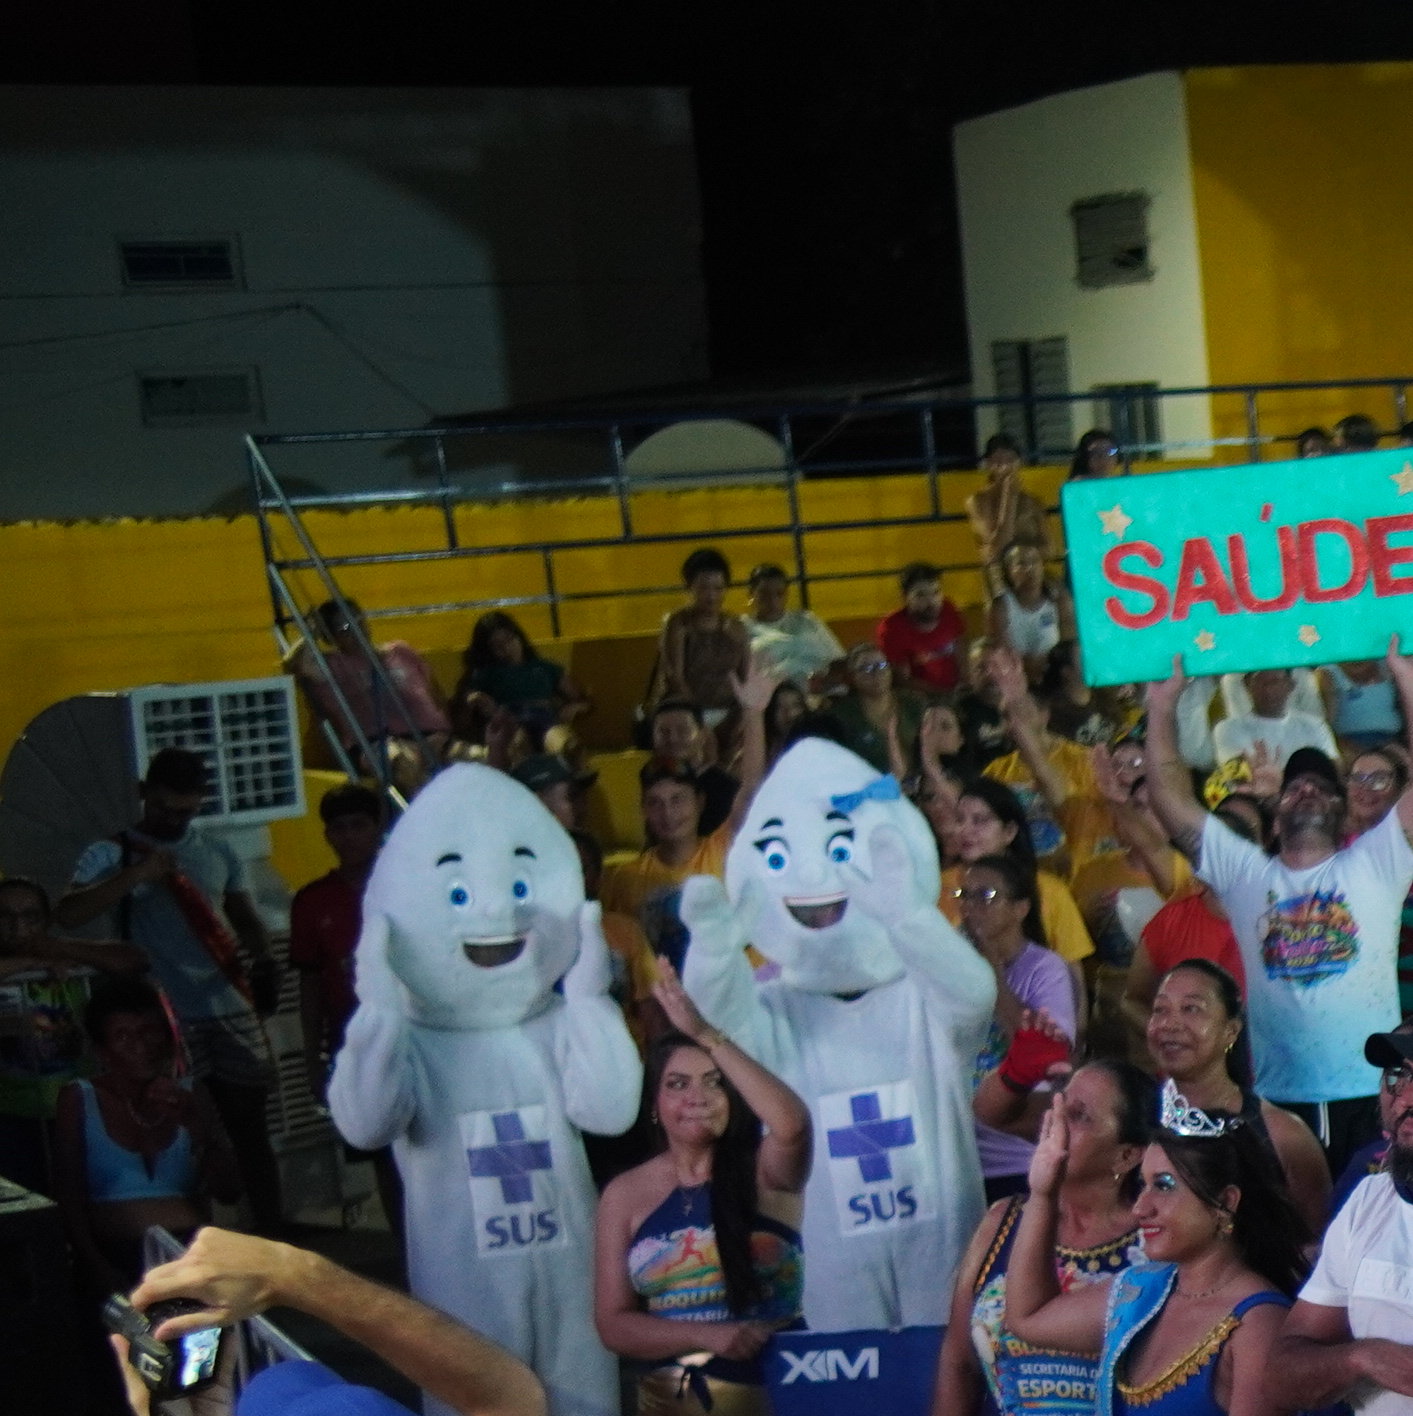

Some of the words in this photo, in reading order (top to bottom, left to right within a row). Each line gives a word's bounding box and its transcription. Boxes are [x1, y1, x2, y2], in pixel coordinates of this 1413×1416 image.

[848, 1185, 917, 1225] SUS
[485, 1208, 558, 1249] SUS
[1019, 1362, 1088, 1377] SECRETARIA
[1016, 1379, 1098, 1401] ESPORT
